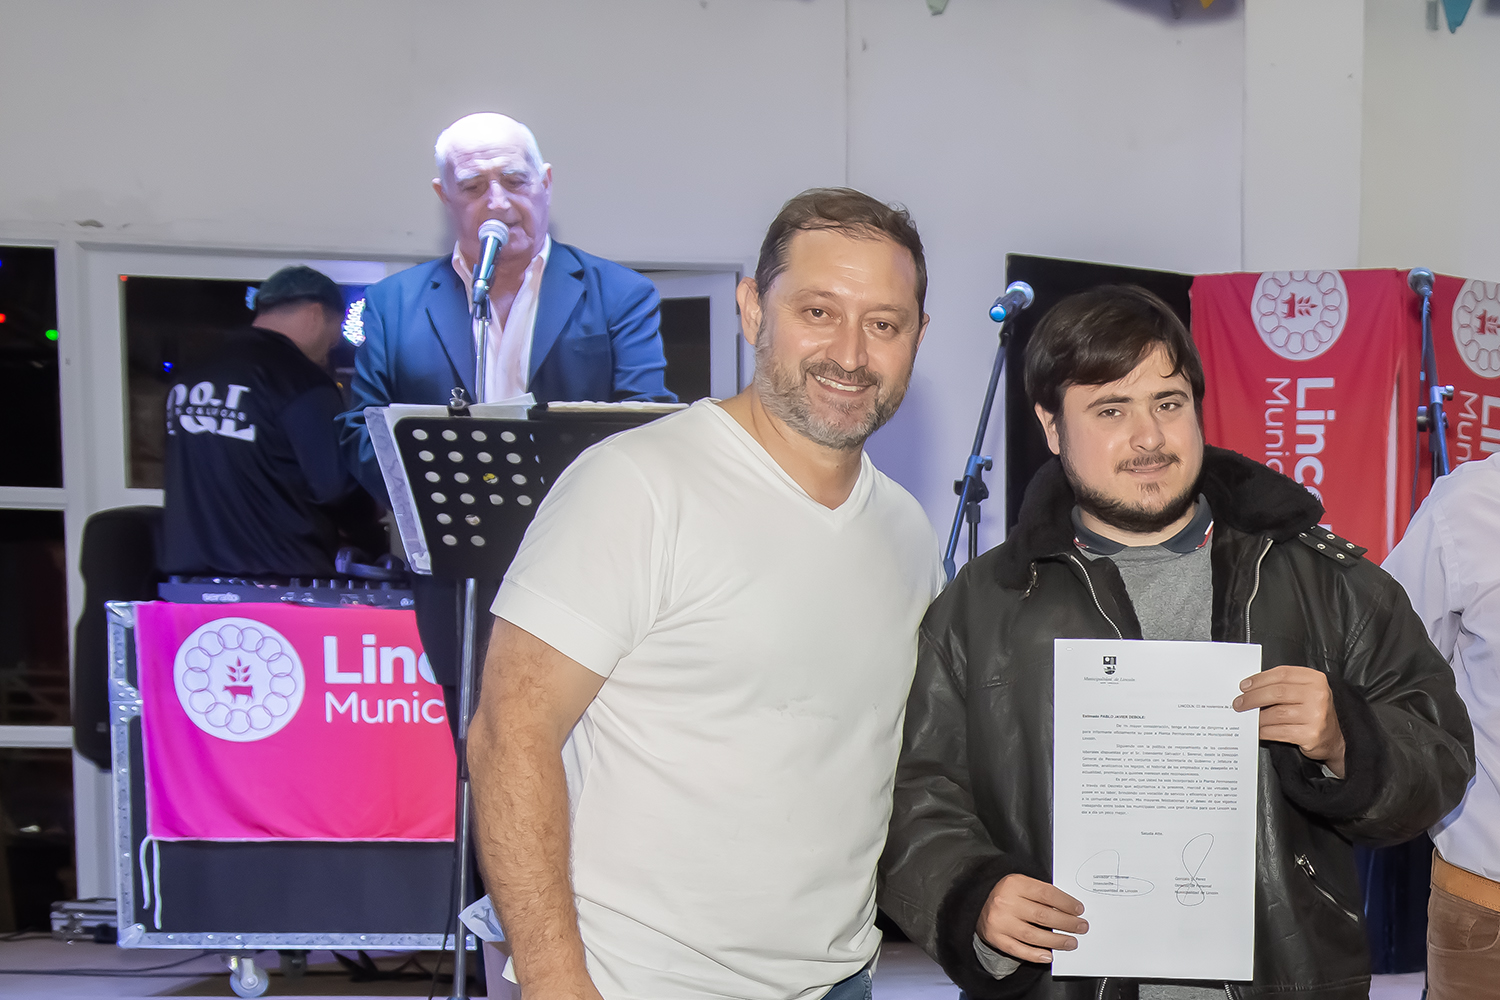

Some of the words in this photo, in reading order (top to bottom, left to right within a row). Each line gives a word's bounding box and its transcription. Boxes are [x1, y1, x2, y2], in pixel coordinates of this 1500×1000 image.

[1264, 377, 1291, 474] Munic
[1294, 377, 1335, 503] Linc
[1456, 390, 1479, 463] Mun
[323, 634, 442, 685] Linc
[325, 691, 446, 724] Munic
